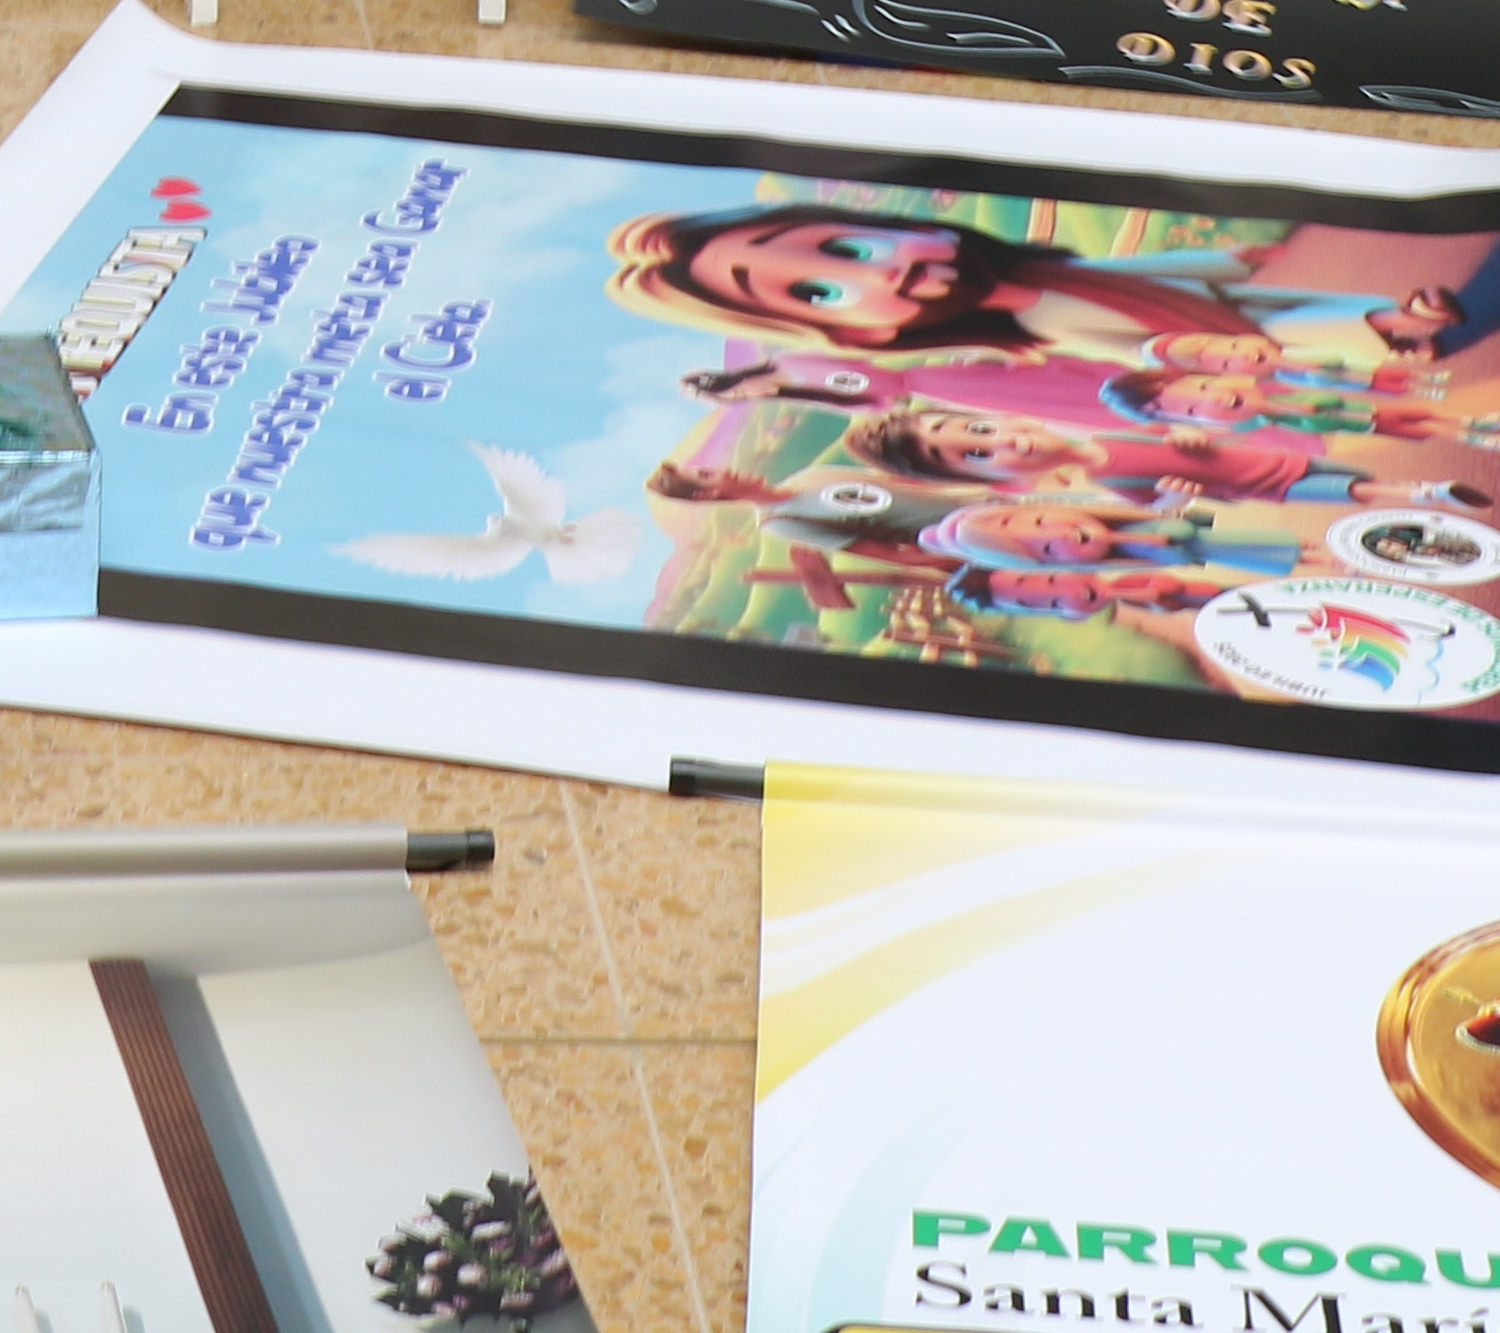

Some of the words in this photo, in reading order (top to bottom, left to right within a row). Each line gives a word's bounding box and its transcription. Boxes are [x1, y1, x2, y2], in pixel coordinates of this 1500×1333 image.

[1115, 32, 1317, 89] DIOS
[121, 390, 220, 434] En
[173, 323, 262, 389] este
[373, 370, 452, 404] el
[188, 485, 281, 552] que
[912, 1258, 1206, 1330] Santa
